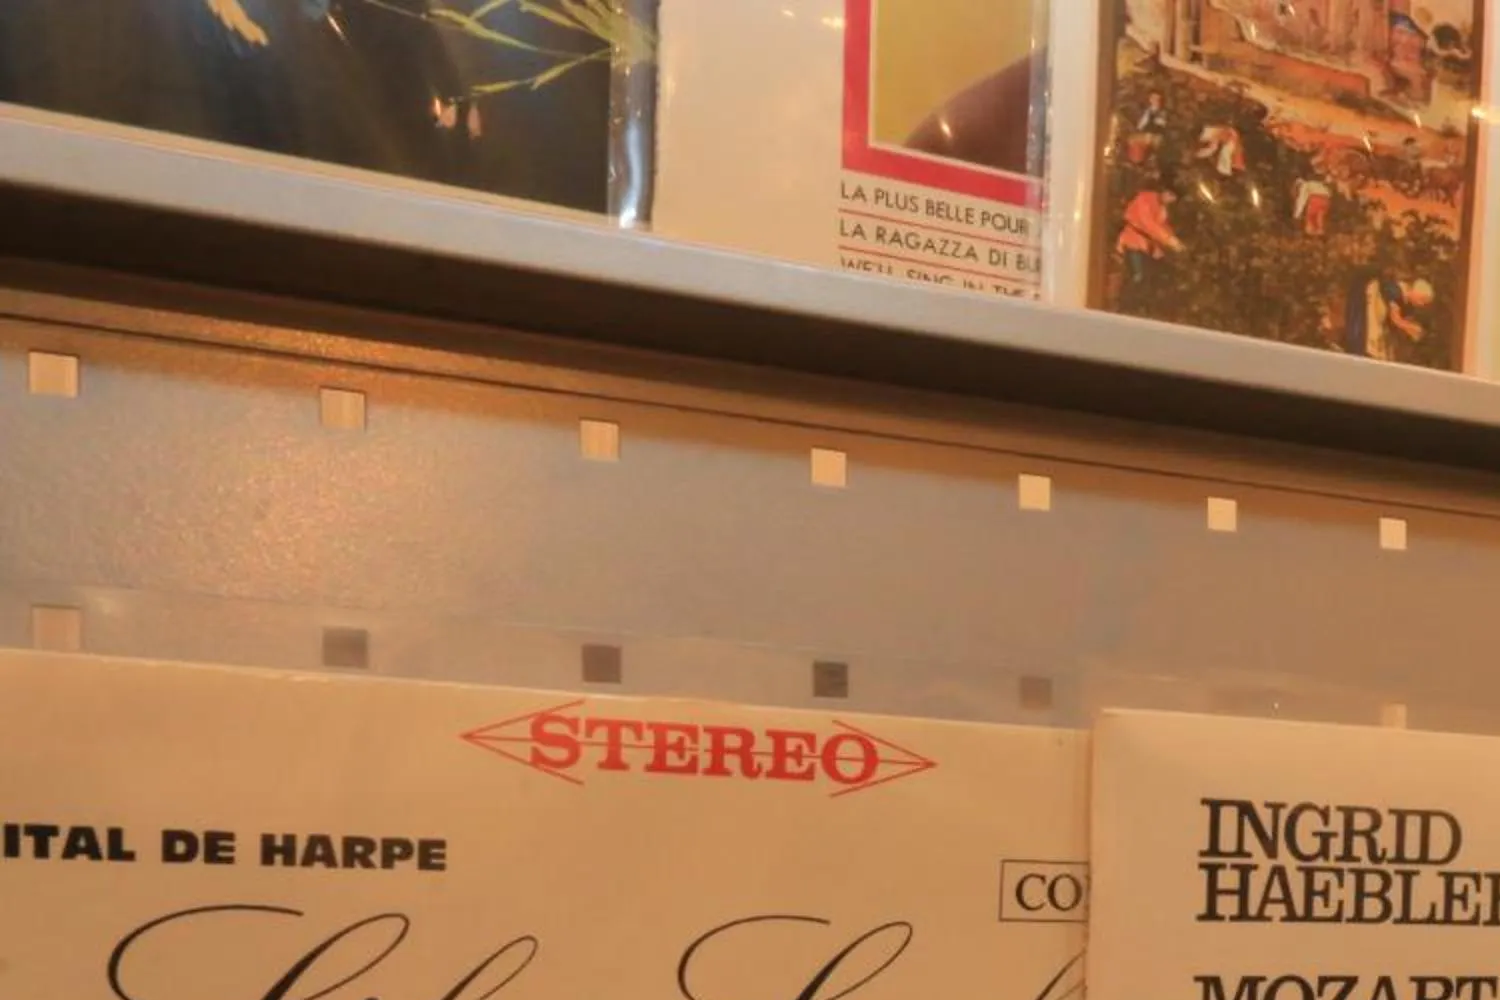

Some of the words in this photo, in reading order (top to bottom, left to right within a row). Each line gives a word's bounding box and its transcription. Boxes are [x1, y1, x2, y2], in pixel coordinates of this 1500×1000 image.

[841, 181, 867, 202] LA
[874, 187, 919, 213] PLUS
[925, 199, 975, 224] BELLE
[981, 211, 1030, 235] POUR
[839, 218, 867, 240] LA
[875, 226, 979, 265] RAGAZZA
[988, 247, 1008, 267] DI
[529, 713, 880, 785] STEREO
[3, 823, 136, 862] ITAL
[161, 828, 236, 864] DE
[260, 833, 447, 872] HARPE
[1198, 797, 1463, 866] INGRID
[1015, 873, 1083, 912] CO
